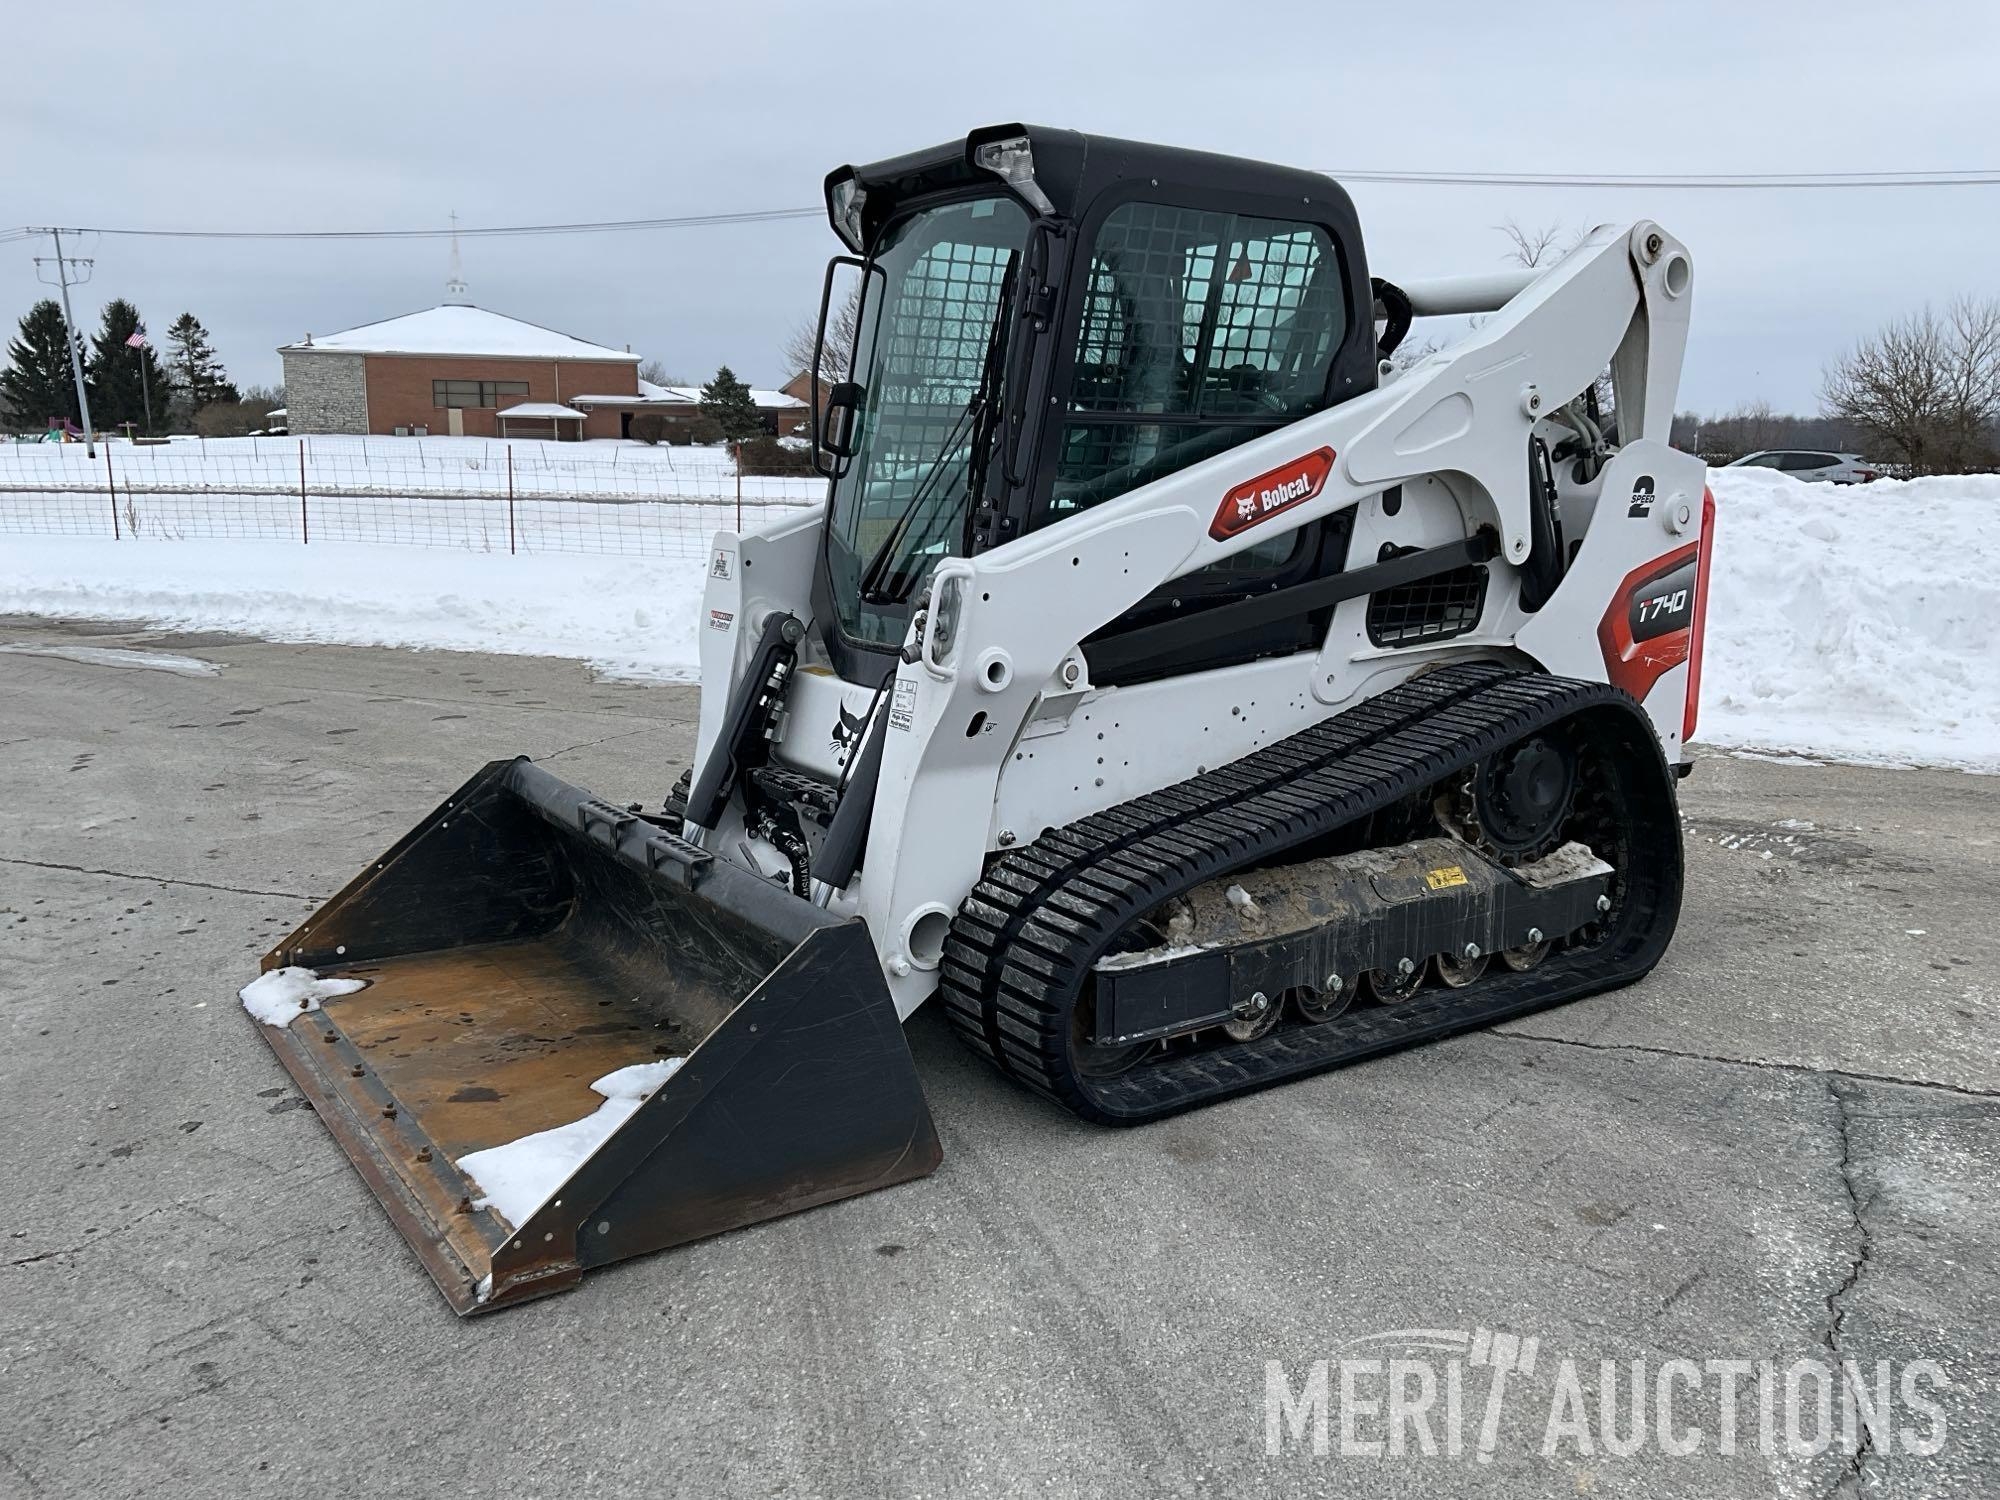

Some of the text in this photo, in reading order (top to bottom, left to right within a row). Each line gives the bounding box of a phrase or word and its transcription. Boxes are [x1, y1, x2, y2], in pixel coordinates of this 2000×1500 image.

[1261, 472, 1311, 512] Bobcat
[1627, 475, 1655, 518] 2
[1630, 494, 1656, 504] SPEED
[1639, 589, 1688, 623] T740
